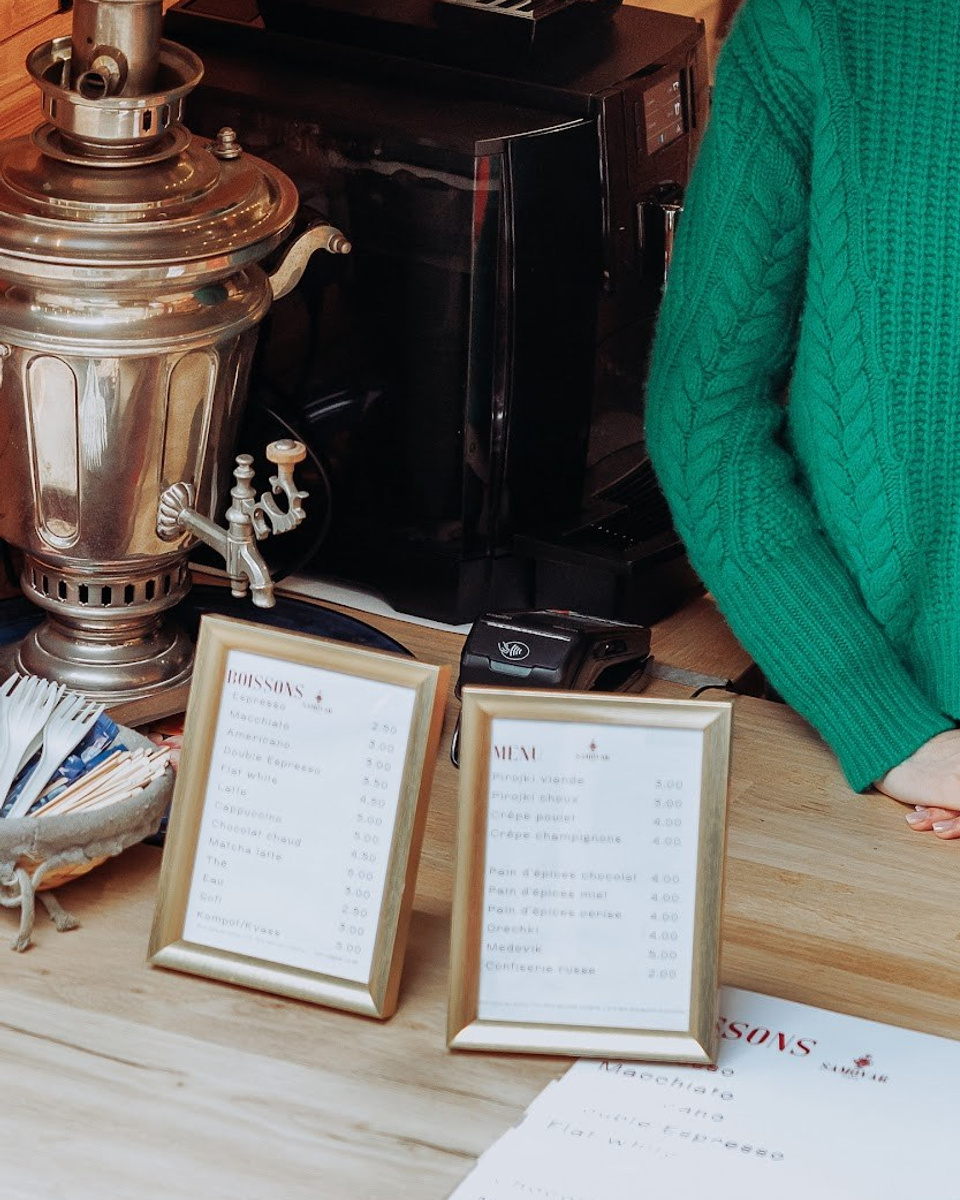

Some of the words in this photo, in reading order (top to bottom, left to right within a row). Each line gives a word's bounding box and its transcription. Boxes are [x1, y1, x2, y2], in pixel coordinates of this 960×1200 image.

[226, 669, 305, 698] BOISSONS
[232, 690, 286, 711] Espresso
[229, 710, 290, 731] Macchiato
[226, 728, 291, 750] Americano
[223, 745, 263, 762] Double
[267, 754, 321, 775] Espresso
[493, 745, 543, 762] MENU
[217, 783, 247, 797] Latte
[211, 818, 262, 838] Chocolat
[266, 831, 302, 847] chaud
[208, 837, 252, 855] Matcha
[202, 873, 224, 886] Eau
